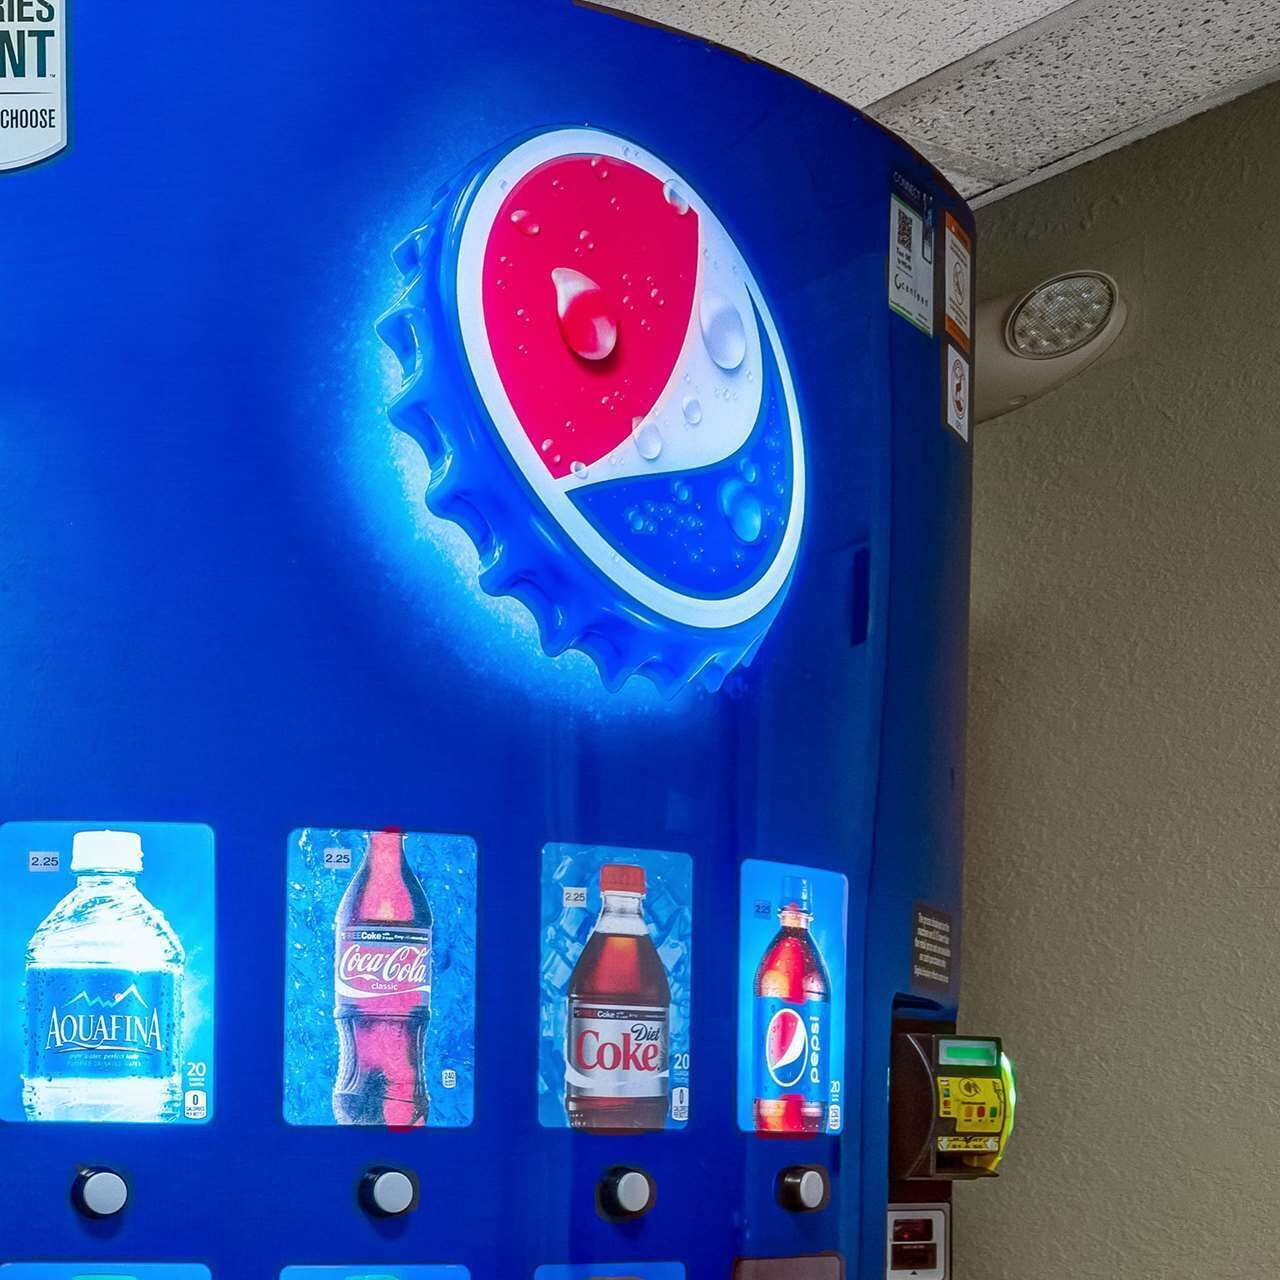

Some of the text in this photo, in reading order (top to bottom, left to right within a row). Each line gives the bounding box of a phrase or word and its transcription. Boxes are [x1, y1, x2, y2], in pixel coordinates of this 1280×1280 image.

[0, 108, 56, 129] CHOOSE
[31, 856, 59, 867] 2.25
[325, 853, 351, 864] 2.25
[565, 892, 586, 902] 2.25
[339, 943, 430, 982] Coca-Cola
[371, 982, 398, 990] classic
[44, 1005, 164, 1051] AQUAFINA
[630, 1023, 660, 1041] Diet
[576, 1029, 659, 1072] Coke
[809, 1015, 820, 1083] pepsi
[187, 1061, 206, 1077] 20
[673, 1053, 689, 1069] 20
